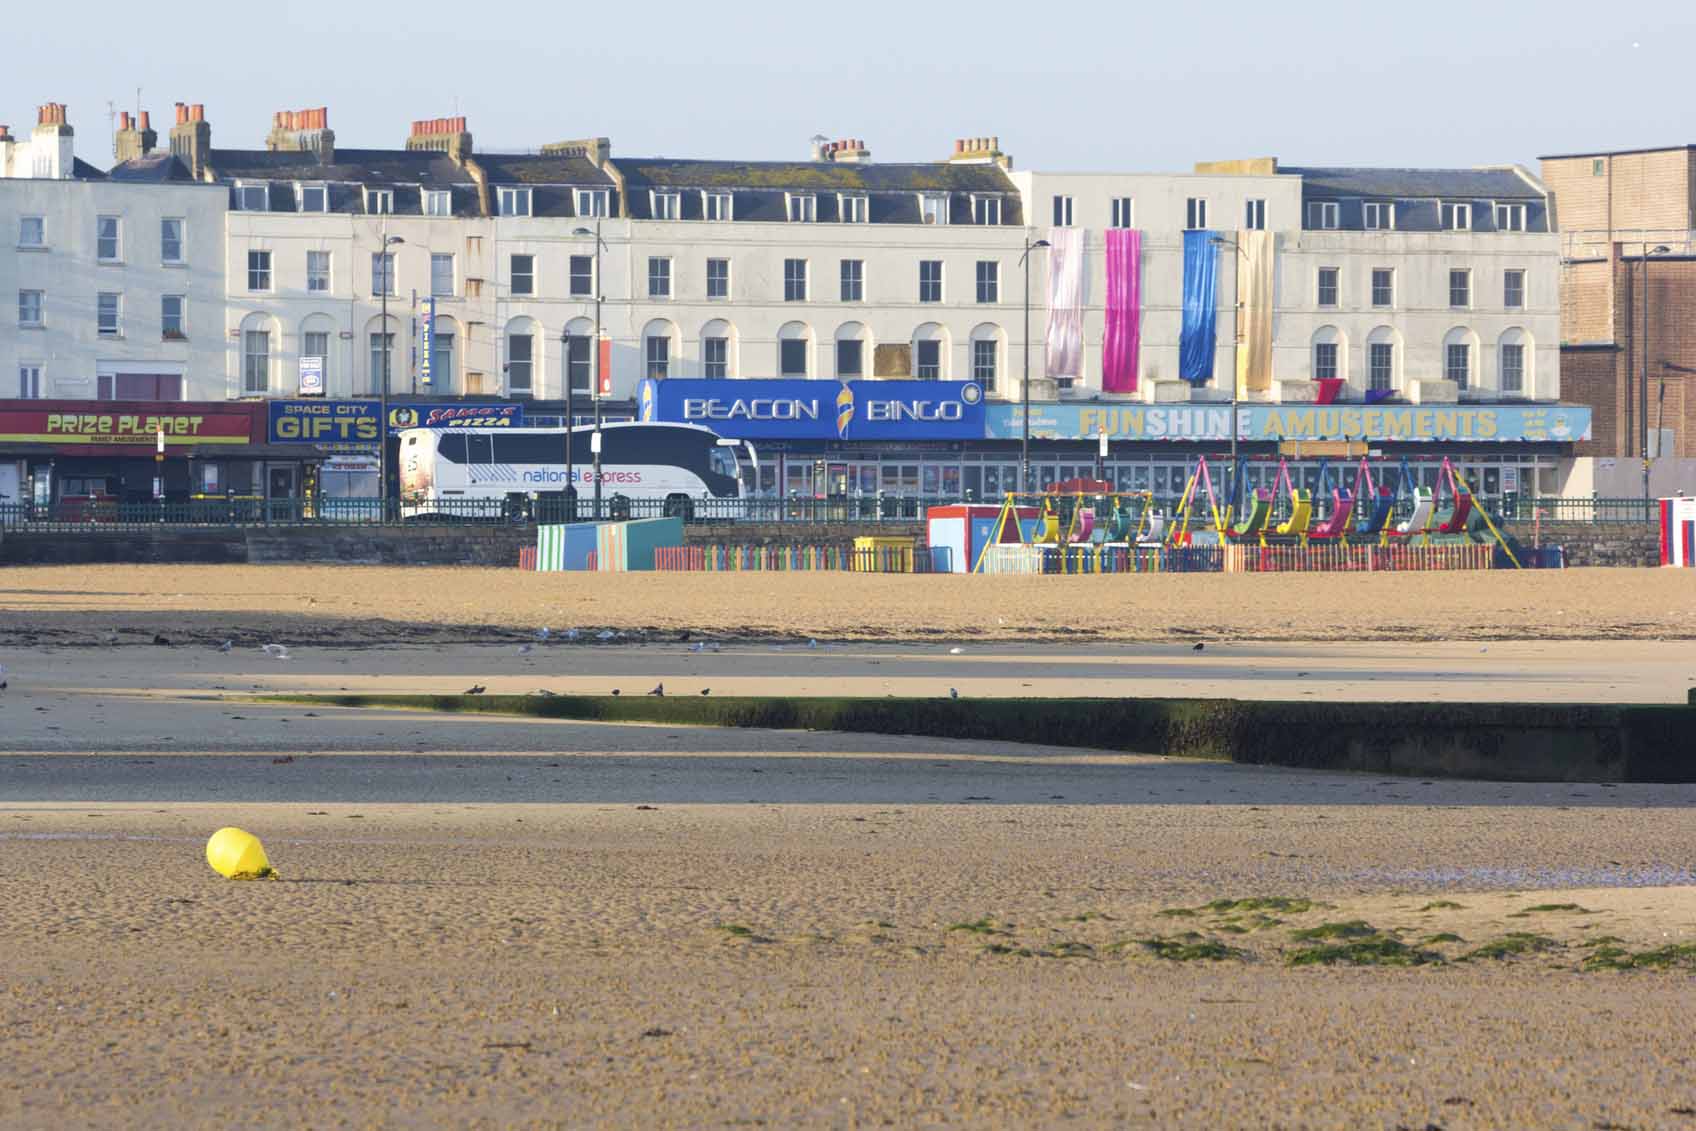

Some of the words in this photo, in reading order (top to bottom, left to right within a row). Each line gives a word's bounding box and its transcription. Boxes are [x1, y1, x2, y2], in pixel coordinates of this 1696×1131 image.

[284, 405, 330, 415] SPACE
[336, 405, 368, 415] CITY
[684, 398, 818, 420] BEACON
[867, 399, 963, 421] BINGO
[276, 416, 378, 439] GIFTS
[448, 417, 511, 427] PIZZA
[1079, 408, 1252, 436] FUNSHINE
[1263, 409, 1498, 438] AMUSEMENTS
[523, 467, 580, 482] national
[584, 471, 641, 486] epress
